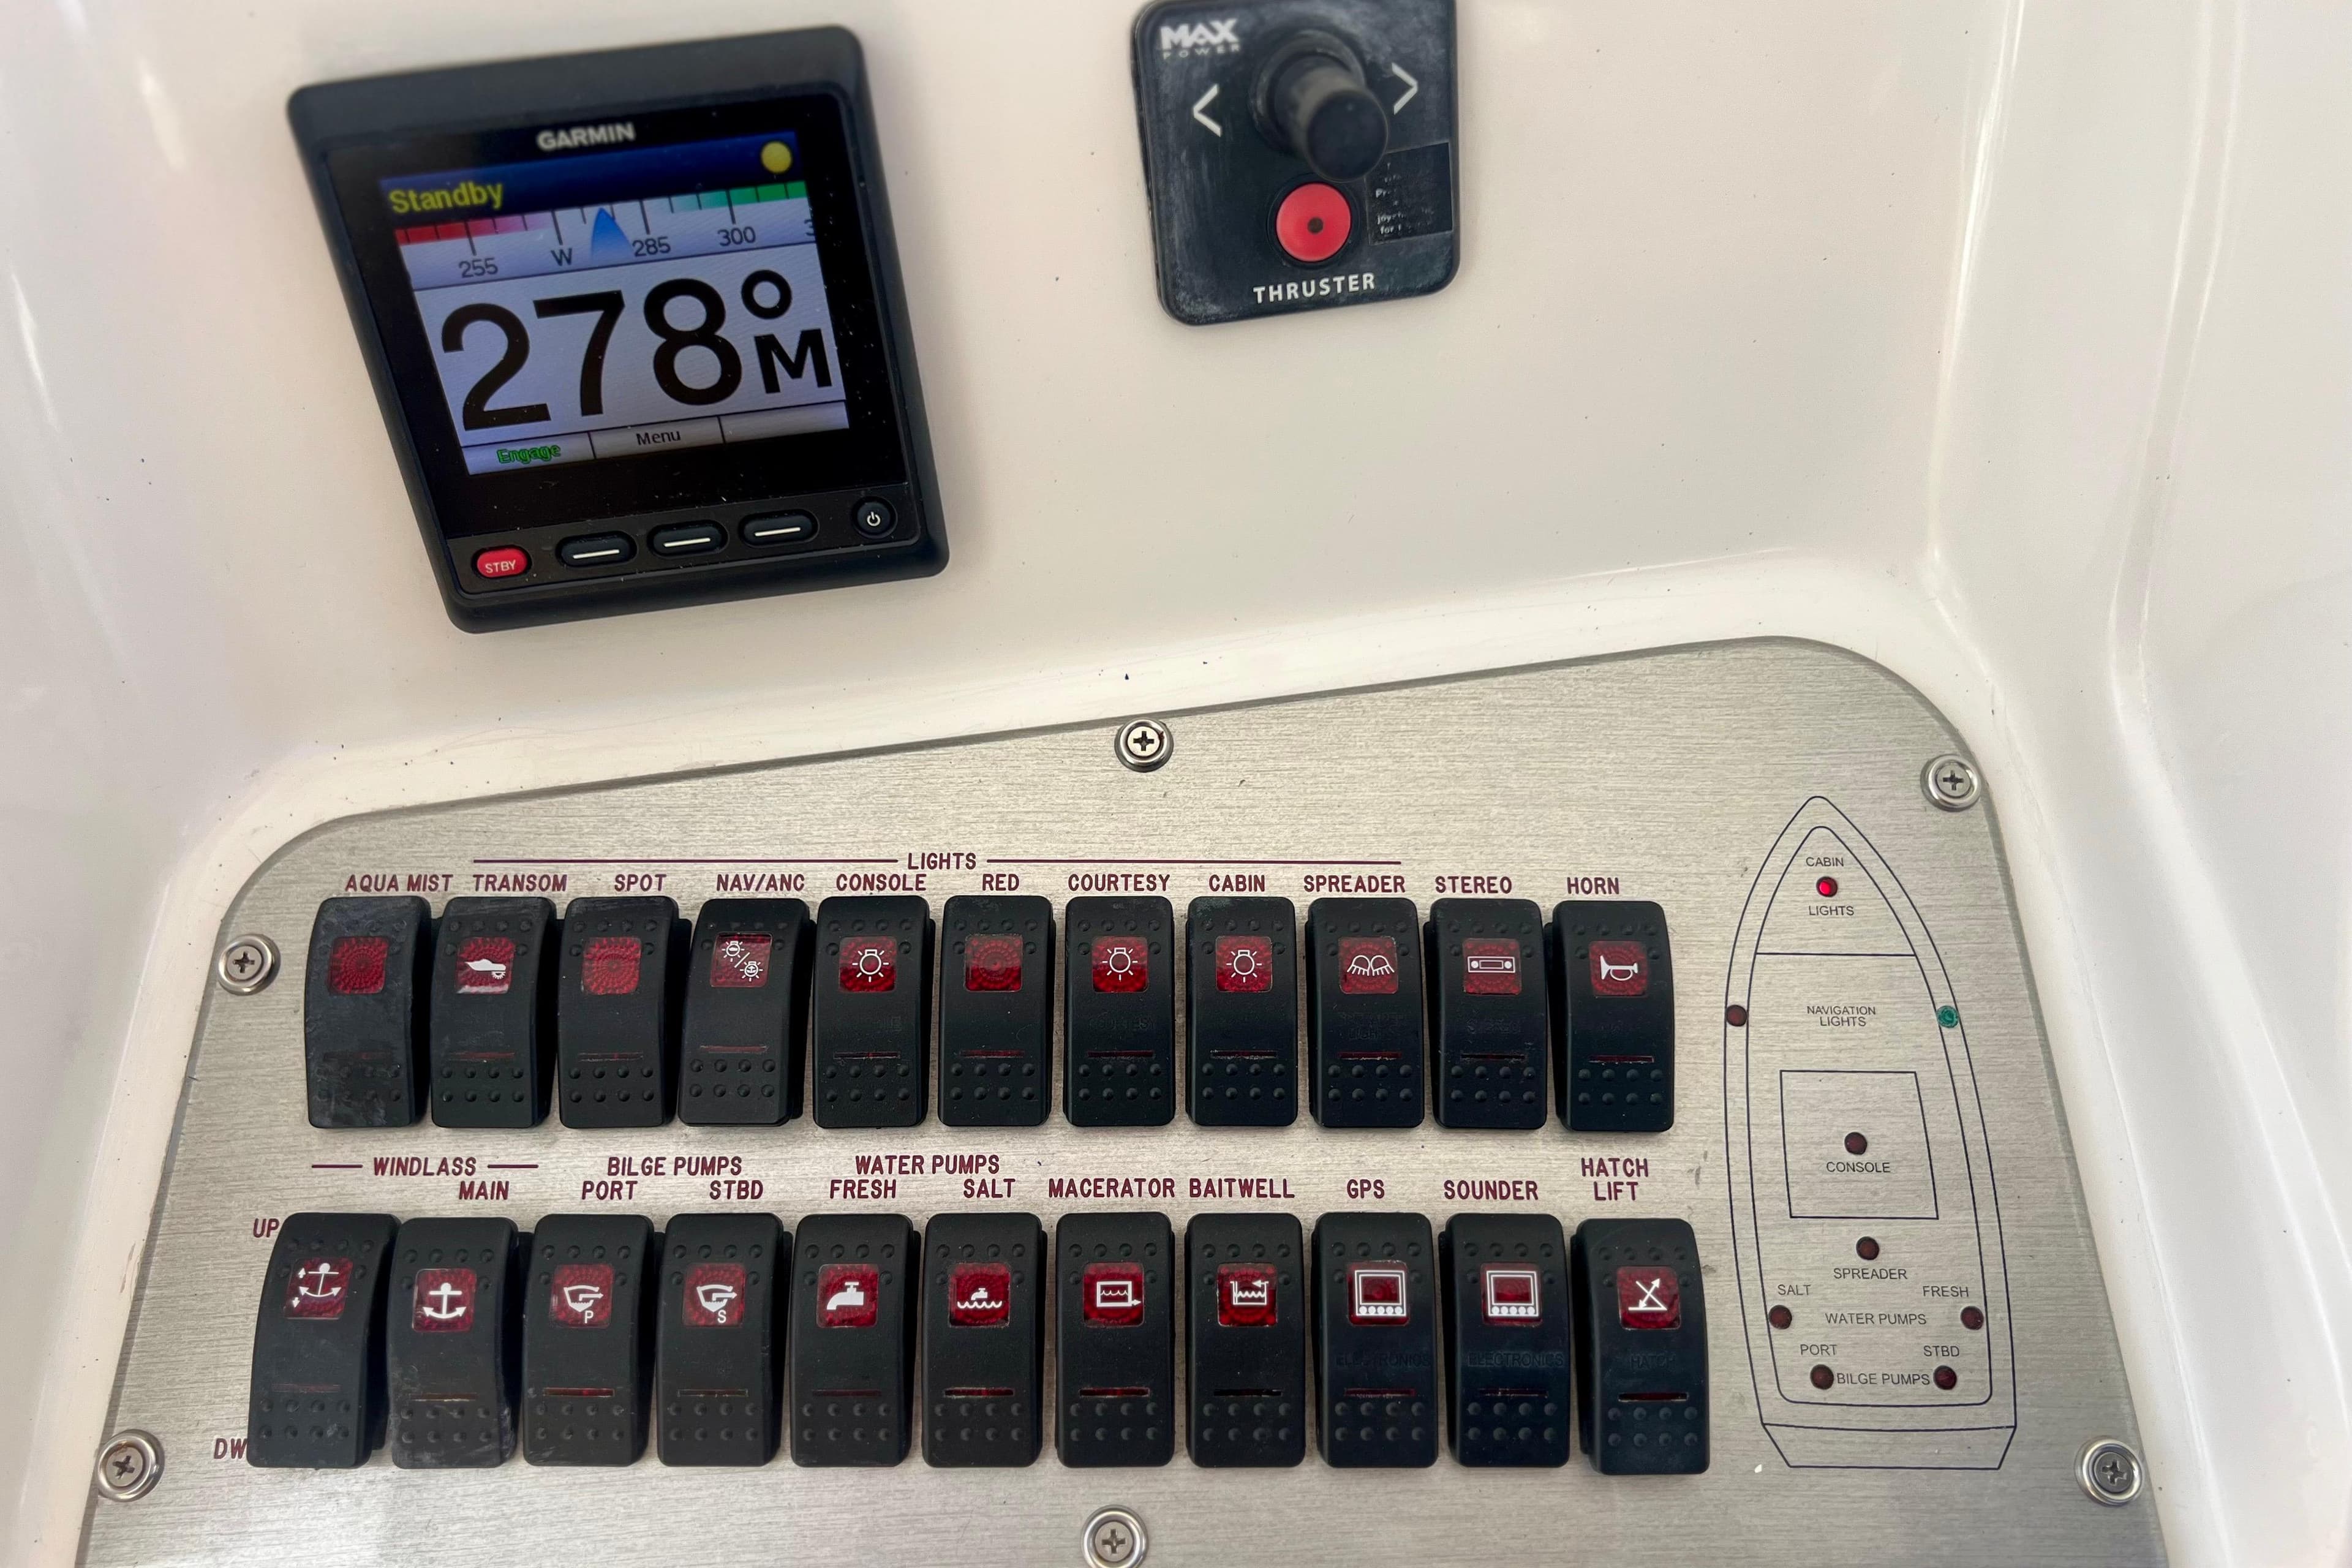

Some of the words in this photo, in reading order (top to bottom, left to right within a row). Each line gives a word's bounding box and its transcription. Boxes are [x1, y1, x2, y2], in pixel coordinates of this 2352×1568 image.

[1161, 18, 1238, 50] MAX
[1163, 43, 1240, 59] POWER
[537, 123, 635, 151] GARMIN
[389, 182, 502, 213] Standby
[458, 257, 499, 278] 255
[551, 247, 573, 266] W
[632, 238, 671, 257] 285
[718, 226, 756, 246] 300
[1253, 273, 1376, 304] THRUSTER
[755, 329, 832, 394] M
[497, 444, 561, 464] Engage
[636, 431, 681, 446] Menu
[484, 559, 516, 574] STBY
[907, 852, 976, 870] LIGHTS
[1806, 857, 1844, 867] CABIN
[345, 874, 399, 892] AQUA
[407, 874, 453, 892] MIST
[473, 874, 568, 892] TRANSOM
[614, 874, 667, 892] SPOT
[716, 873, 805, 892] NAV/ANC
[836, 873, 927, 892] CONSOLE
[982, 873, 1020, 891] RED
[1068, 873, 1170, 892] COURTESY
[1208, 874, 1265, 892] CABIN
[1303, 875, 1406, 893] SPREADER
[1435, 876, 1512, 894] STEREO
[1567, 876, 1619, 895] HORN
[1808, 905, 1855, 917] LIGHTS
[1806, 1005, 1876, 1016] NAVIGATION
[1819, 1016, 1867, 1027] LIGHTS
[374, 1156, 477, 1176] WINDLASS
[607, 1156, 666, 1177] BILGE
[674, 1156, 742, 1176] PUMPS
[855, 1155, 924, 1175] WATER
[932, 1155, 1000, 1174] PUMPS
[1581, 1157, 1649, 1177] HATCH
[1826, 1161, 1891, 1174] CONSOLE
[459, 1181, 509, 1200] MAIN
[581, 1181, 638, 1200] PORT
[709, 1180, 763, 1199] STBD
[830, 1179, 897, 1199] FRESH
[963, 1178, 1016, 1198] SALT
[1049, 1178, 1175, 1198] MACERATOR
[1189, 1178, 1295, 1198] BAITWELL
[1346, 1179, 1385, 1199] GPS
[1444, 1180, 1538, 1200] SOUNDER
[1594, 1182, 1638, 1201] LIFT
[253, 1218, 279, 1238] UP
[1833, 1267, 1907, 1280] SPREADER
[1777, 1284, 1811, 1296] SALT
[1922, 1286, 1969, 1298] FRESH
[1825, 1313, 1875, 1325] WATER
[1879, 1313, 1927, 1325] PUMPS
[1800, 1344, 1837, 1355] PORT
[1923, 1345, 1960, 1357] STBD
[1837, 1372, 1877, 1385] BILGE
[1882, 1373, 1931, 1385] PUMPS
